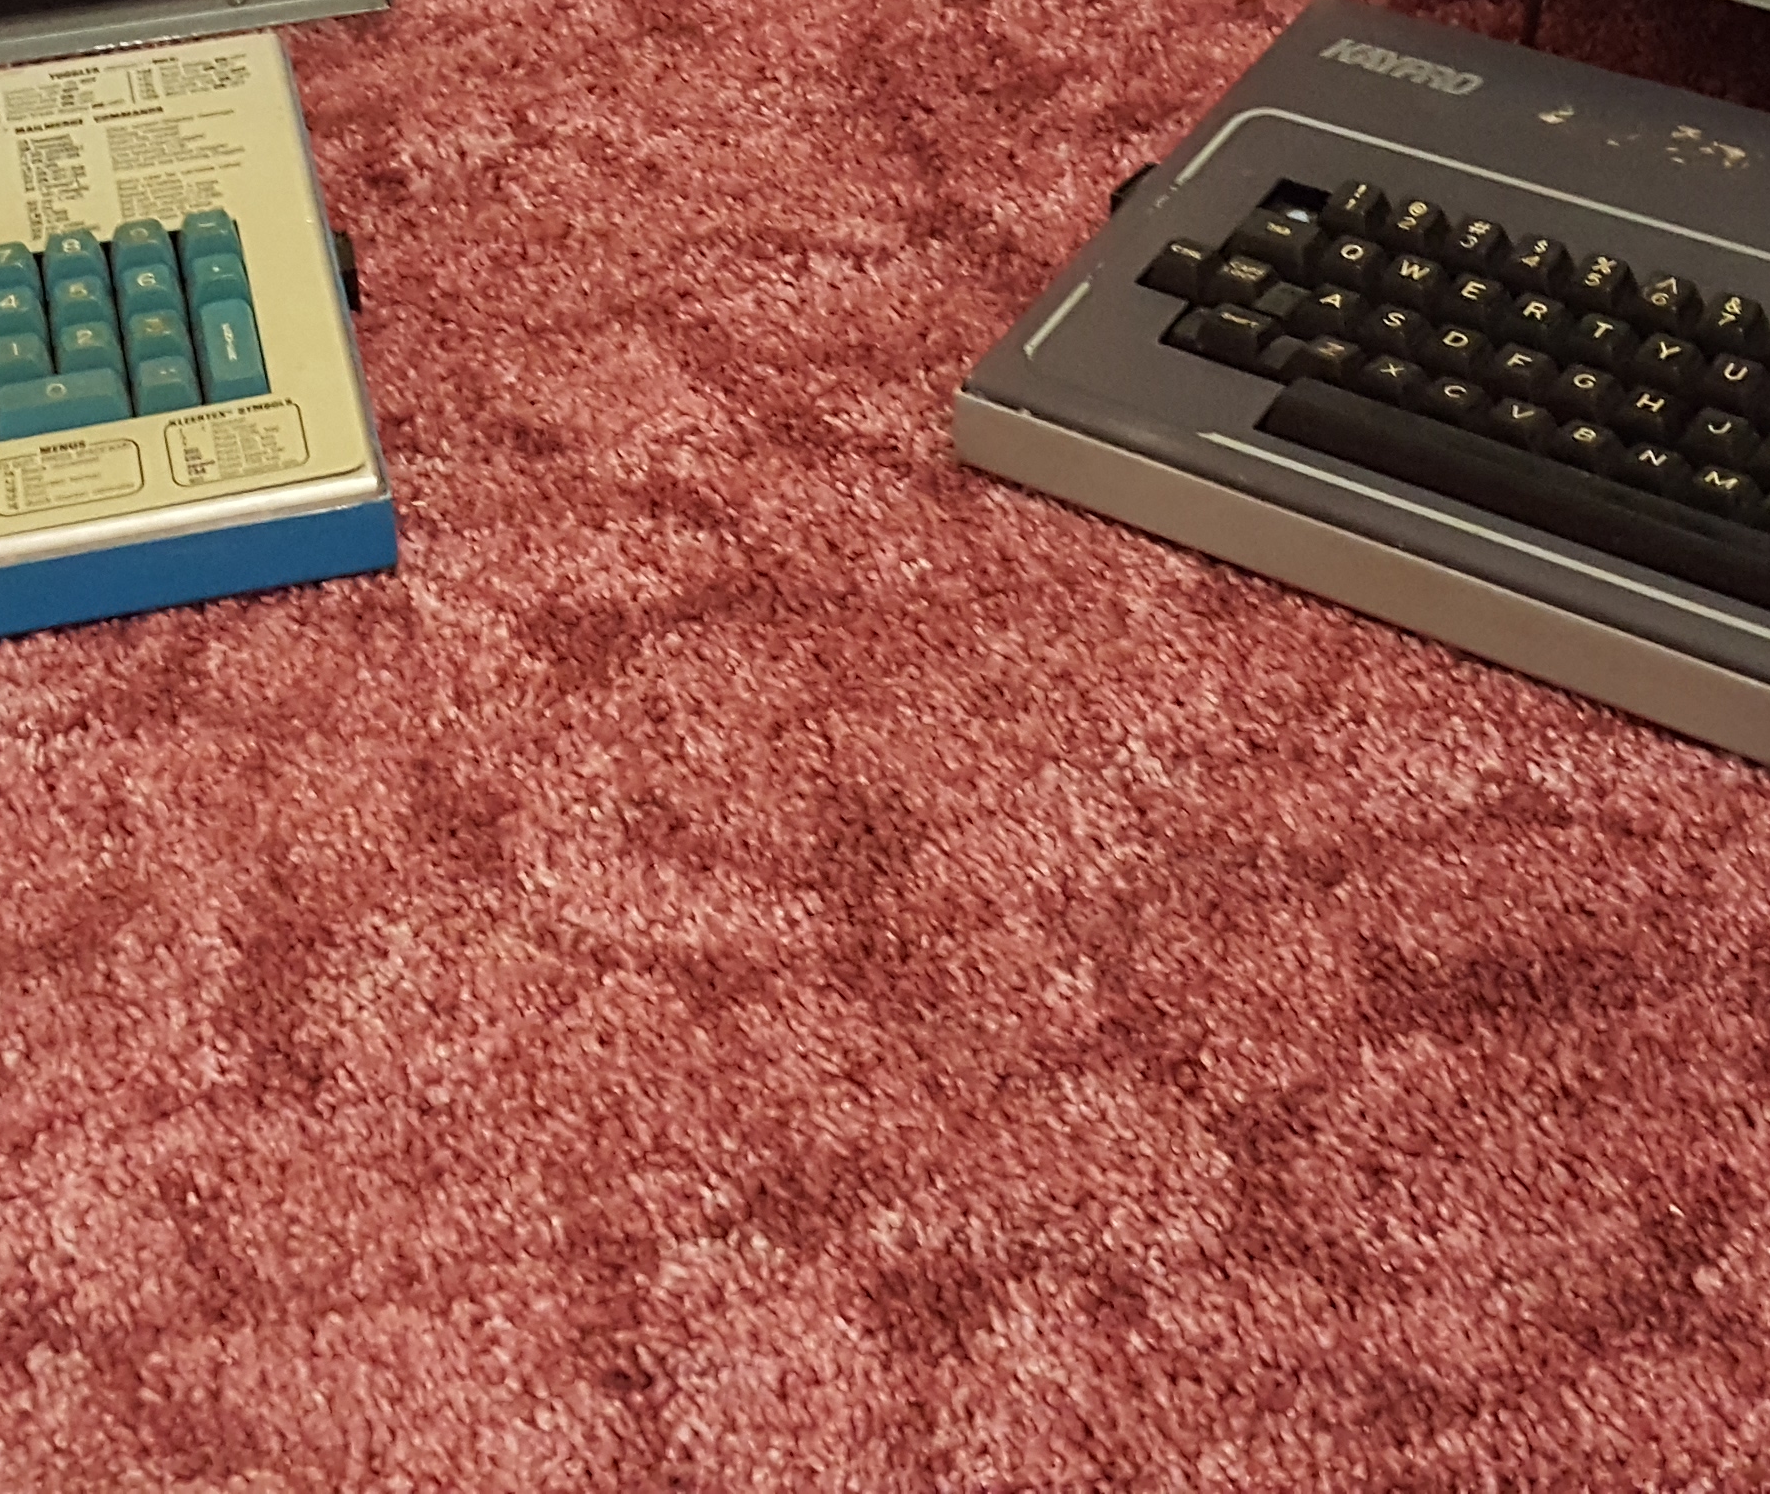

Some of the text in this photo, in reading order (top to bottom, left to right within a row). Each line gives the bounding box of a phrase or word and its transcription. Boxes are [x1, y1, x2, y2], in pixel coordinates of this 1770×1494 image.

[1319, 38, 1484, 95] KAYPRO
[1398, 217, 1416, 230] 2
[62, 239, 80, 252] 8
[1460, 235, 1478, 248] 3
[1341, 245, 1363, 260] Q
[1521, 256, 1540, 267] 4
[1400, 260, 1429, 279] W
[137, 273, 156, 286] 6
[1585, 273, 1602, 285] 5
[1462, 281, 1486, 299] E
[1320, 294, 1341, 308] A
[1651, 293, 1669, 305] 6
[1523, 302, 1547, 319] R
[1383, 313, 1405, 326] S
[1719, 312, 1735, 325] 7
[1594, 321, 1613, 337] T
[1443, 331, 1468, 347] D
[1660, 342, 1680, 359] Y
[1508, 353, 1532, 365] F
[1381, 363, 1404, 376] X
[1724, 363, 1747, 380] U
[1574, 374, 1596, 388] G
[1444, 386, 1466, 397] C
[1637, 394, 1664, 412] H
[1513, 405, 1534, 418] V
[1708, 422, 1731, 433] J
[1574, 428, 1596, 441] B
[1639, 450, 1666, 466] N
[1705, 471, 1738, 489] M
